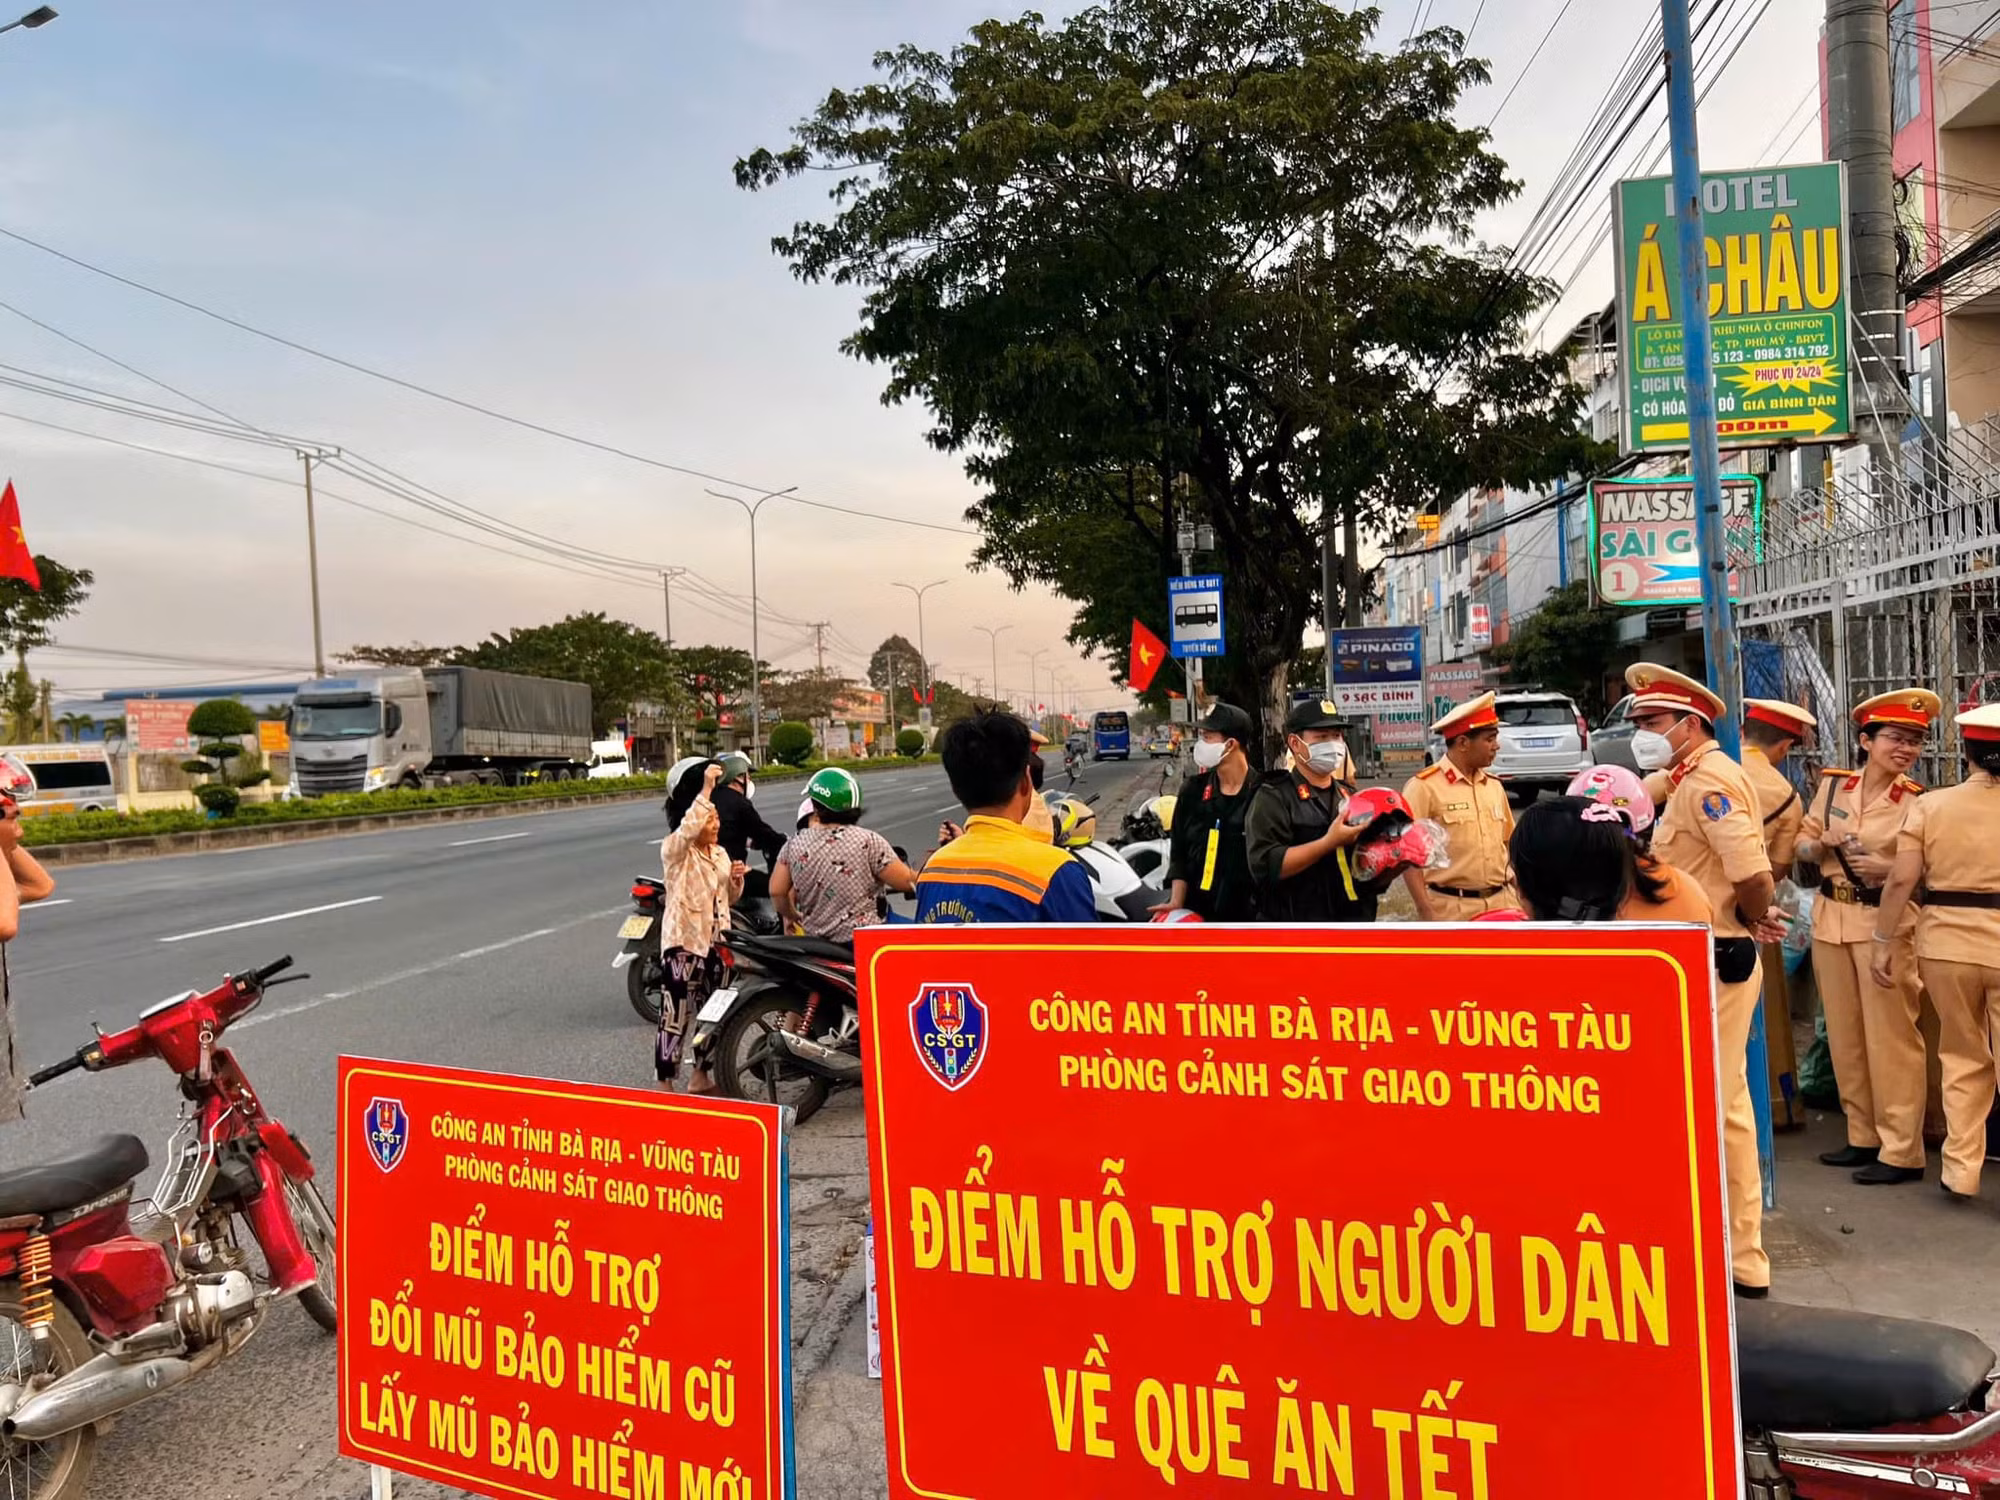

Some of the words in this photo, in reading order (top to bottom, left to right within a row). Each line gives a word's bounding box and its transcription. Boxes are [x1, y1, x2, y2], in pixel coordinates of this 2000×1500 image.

[1632, 223, 1673, 322] Á
[1703, 213, 1840, 318] CHÂU
[1714, 326, 1735, 336] KHU
[1775, 319, 1823, 330] CHINFON
[1796, 333, 1825, 345] BRVT
[1664, 354, 1685, 366] 025
[1723, 351, 1743, 363] 123
[1754, 348, 1781, 361] 0984
[1784, 346, 1805, 359] 314
[1808, 344, 1830, 357] 792
[1797, 365, 1821, 379] 24/24
[1642, 398, 1659, 417] CÓ
[1718, 391, 1736, 412] ĐỎ
[1717, 420, 1788, 433] 00m
[1601, 488, 1750, 523] MASSGE
[1612, 571, 1626, 592] 1
[1430, 669, 1480, 681] MASSAGE
[1342, 693, 1350, 703] 9
[813, 782, 832, 798] Grab
[1029, 990, 1113, 1034] CÔNG
[1123, 1001, 1166, 1035] AN
[1175, 990, 1257, 1038] TỈNH
[1269, 996, 1319, 1041] BÀ
[1330, 1006, 1394, 1051] RỊA
[1429, 1000, 1538, 1049] VŨNG
[1549, 1002, 1631, 1051] TÀU
[923, 1031, 977, 1049] CSGT
[1059, 1047, 1168, 1093] PHÒNG
[1177, 1047, 1269, 1097] CẢNH
[1281, 1056, 1349, 1101] SÁT
[1362, 1067, 1451, 1107] GIAO
[1461, 1064, 1602, 1114] THÔNG
[371, 1131, 402, 1145] CSGT
[431, 1111, 477, 1143] CÔNG
[481, 1122, 506, 1147] AN
[510, 1118, 553, 1154] TỈNH
[559, 1127, 585, 1158] BÀ
[590, 1136, 623, 1168] RỊA
[641, 1139, 695, 1175] VŨNG
[699, 1146, 740, 1181] TÀU
[445, 1152, 503, 1185] PHÒNG
[508, 1157, 557, 1193] CẢNH
[562, 1168, 599, 1200] SÁT
[604, 1178, 650, 1208] GIAO
[654, 1183, 723, 1220] THÔNG
[909, 1144, 1042, 1281] ĐIỂM
[1059, 1157, 1136, 1291] HỖ
[1151, 1199, 1274, 1327] TRỢ
[1295, 1201, 1496, 1328] NGƯỜI
[1520, 1212, 1669, 1347] DÂN
[429, 1202, 513, 1286] ĐIỂM
[526, 1218, 574, 1297] HỖ
[584, 1249, 662, 1327] TRỢ
[369, 1279, 422, 1356] ĐỔI
[434, 1306, 483, 1370] MŨ
[495, 1310, 565, 1389] BẢO
[577, 1324, 671, 1414] HIỂM
[684, 1358, 735, 1428] CŨ
[1043, 1333, 1116, 1459] VỀ
[1134, 1364, 1250, 1486] QUÊ
[1273, 1377, 1355, 1496] ĂN
[1371, 1380, 1498, 1500] TẾT
[360, 1370, 417, 1441] LẤY
[428, 1395, 477, 1459] MŨ
[490, 1401, 560, 1480] BẢO
[572, 1418, 665, 1500] HIỂM
